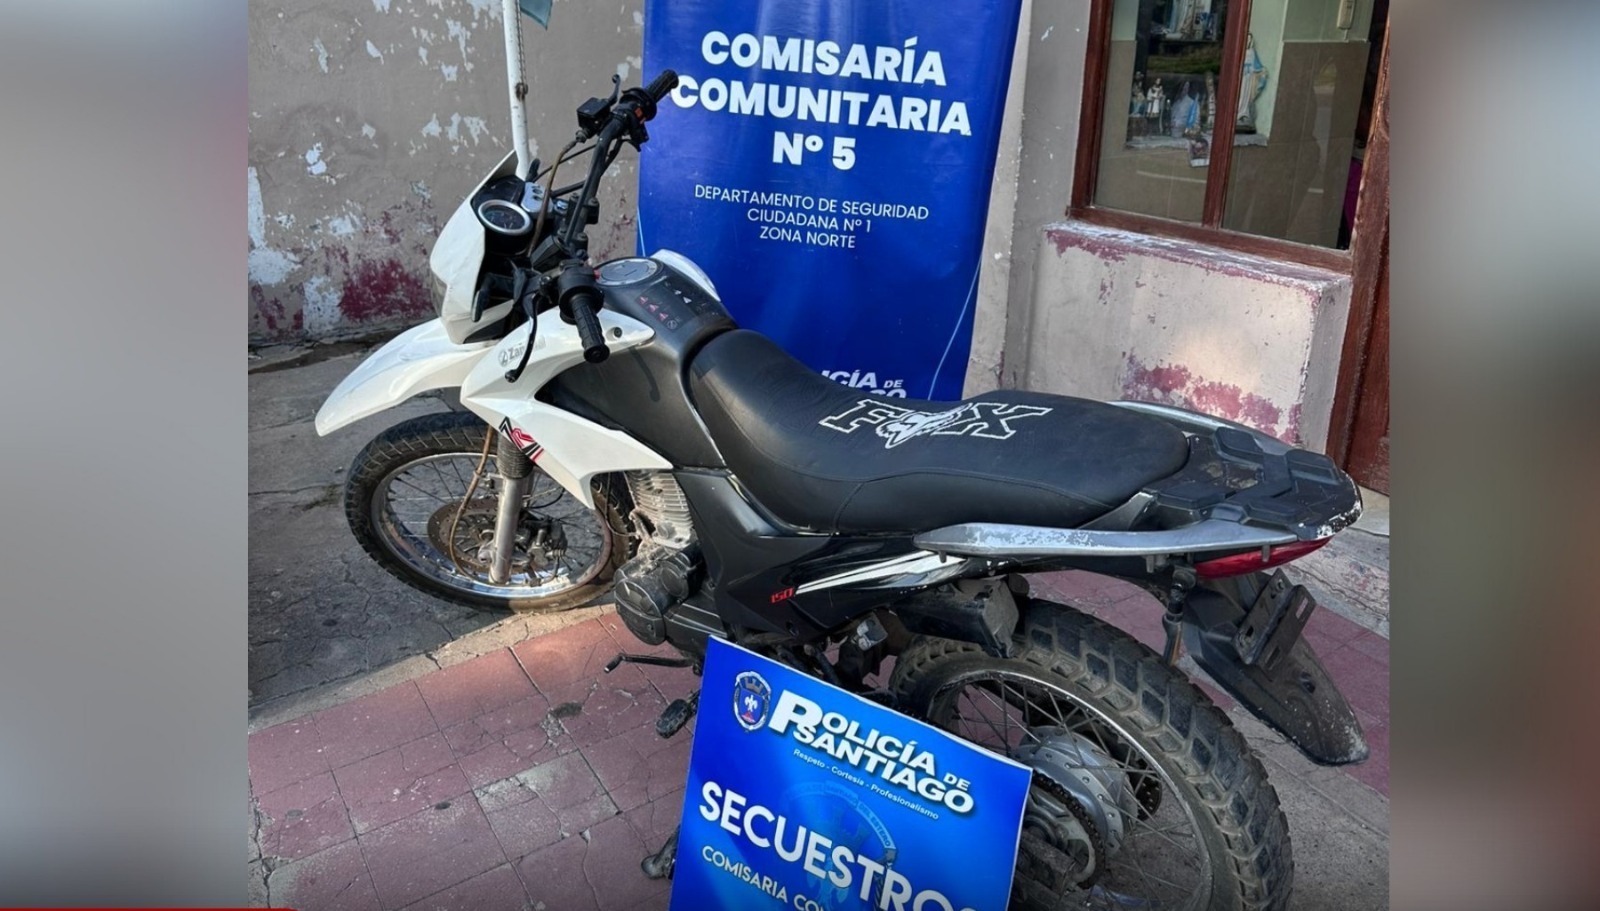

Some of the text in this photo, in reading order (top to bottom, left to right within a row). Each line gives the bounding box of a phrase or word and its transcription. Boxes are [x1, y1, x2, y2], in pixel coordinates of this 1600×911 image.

[702, 30, 947, 86] COMISARÍA
[671, 74, 972, 136] COMUNITARIA
[832, 137, 856, 170] 5
[695, 184, 929, 220] DEPARTAMENTO DE SEGURIDAD
[747, 208, 839, 230] CIUDADANA
[866, 219, 871, 232] 1
[759, 226, 856, 248] ZONA NORTE
[883, 379, 904, 389] DE
[770, 587, 794, 603] 150
[767, 689, 971, 791] POLICÍA DE
[793, 724, 974, 814] SANTIAGO
[793, 749, 825, 769] Respeto
[871, 784, 939, 820] Profesionalismo
[699, 781, 977, 911] SECUESTRO
[702, 845, 788, 903] COMISARIA
